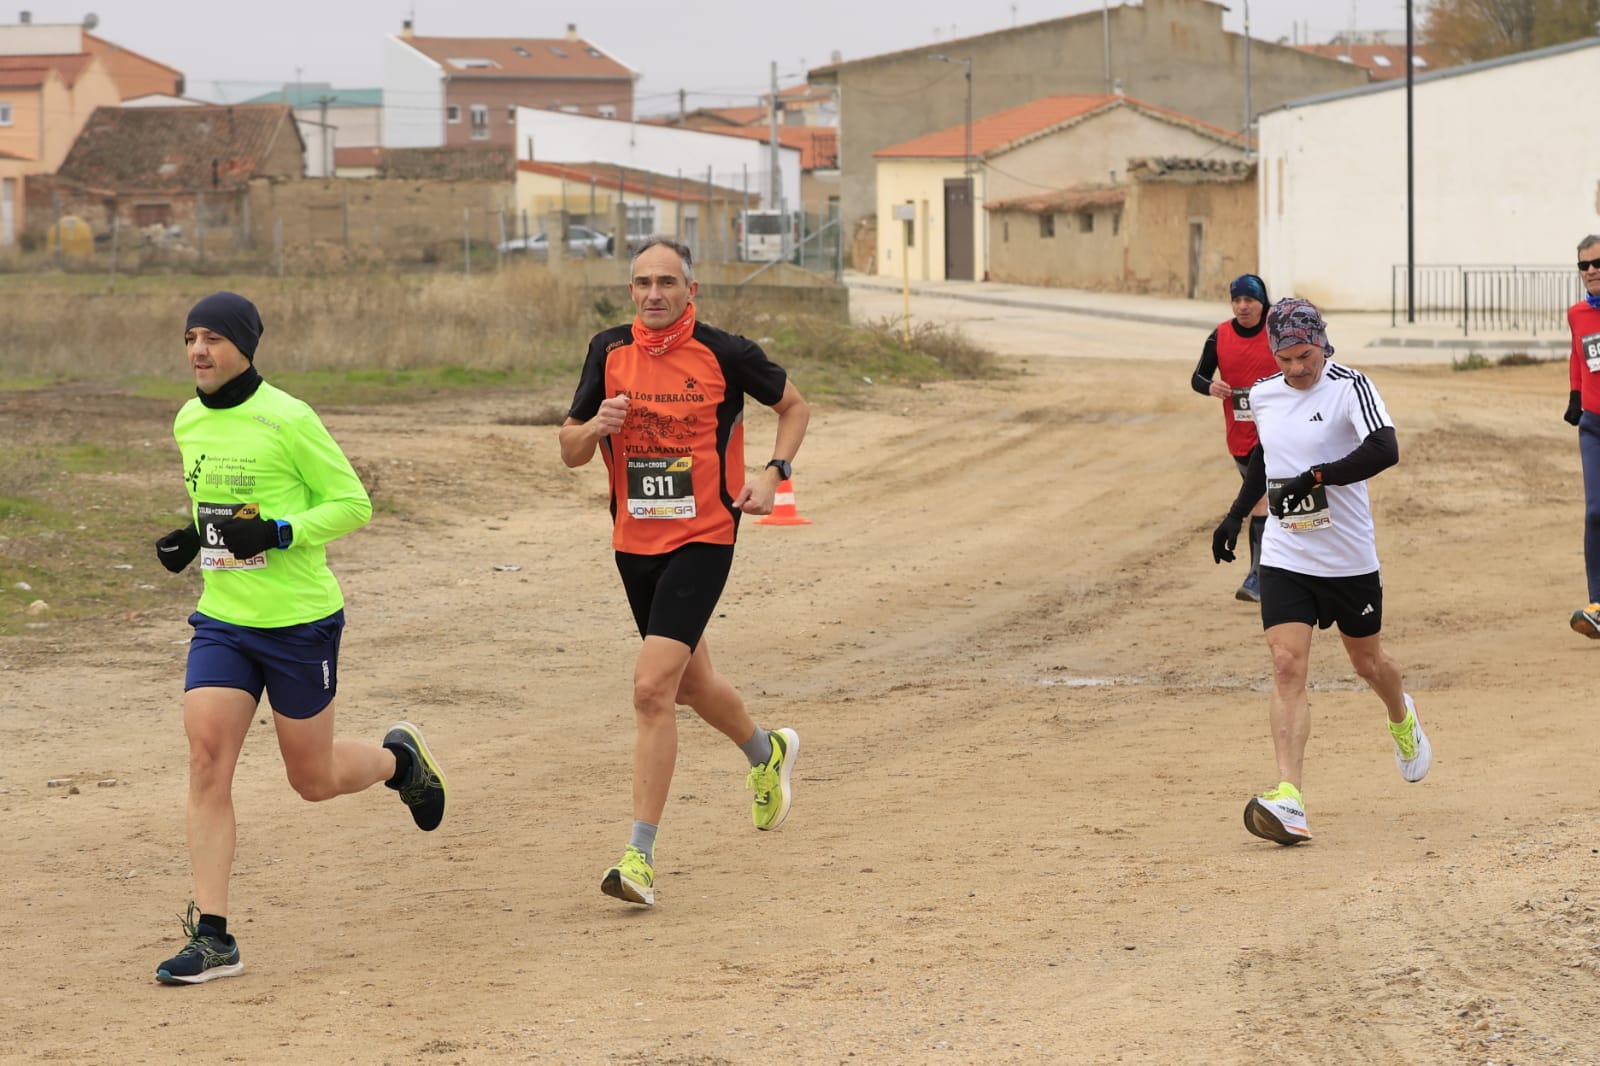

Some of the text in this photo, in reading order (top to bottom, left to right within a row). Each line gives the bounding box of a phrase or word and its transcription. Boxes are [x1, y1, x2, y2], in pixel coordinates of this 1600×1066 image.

[636, 391, 652, 401] LOS
[655, 392, 704, 403] BERRACOS
[1239, 396, 1250, 410] 6
[625, 444, 692, 453] VILLAMAYOR
[642, 475, 674, 496] 611
[632, 505, 693, 515] JOMISAGA
[202, 556, 264, 566] JOMISAGA
